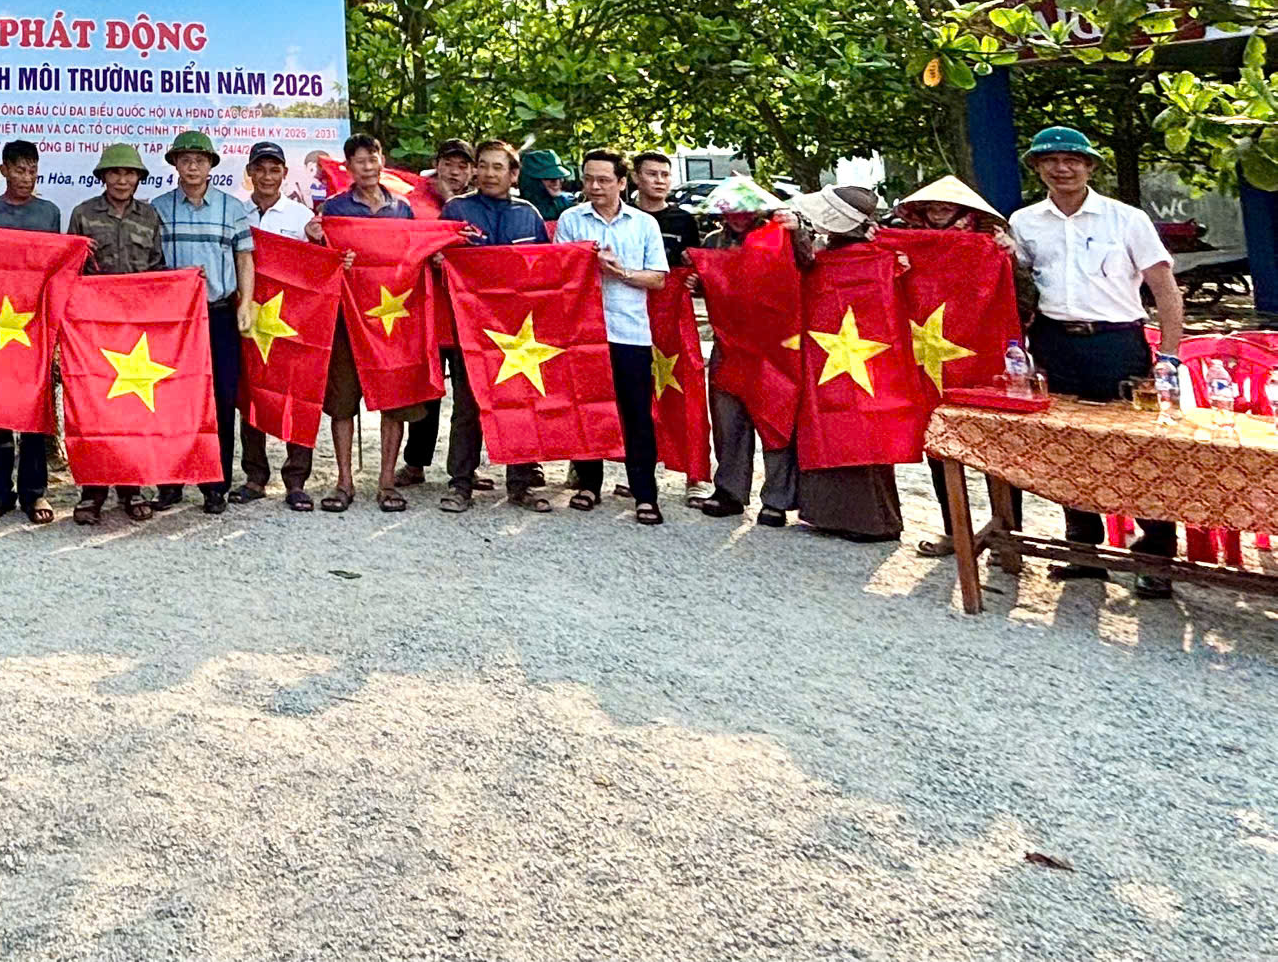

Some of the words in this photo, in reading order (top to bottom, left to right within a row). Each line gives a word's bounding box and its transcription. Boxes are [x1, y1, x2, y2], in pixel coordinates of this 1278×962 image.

[105, 13, 208, 58] ĐỘNG
[18, 62, 60, 91] MÔI
[67, 62, 154, 93] TRƯỜNG
[160, 60, 211, 94] BIỂN
[217, 66, 266, 96] NĂM
[273, 73, 323, 97] 2026
[116, 103, 146, 118] QUỐC
[149, 104, 166, 119] HỘI
[169, 105, 183, 118] VÀ
[185, 108, 215, 119] HĐND
[21, 124, 44, 134] NAM
[213, 124, 232, 138] HỘI
[285, 128, 307, 138] 2026
[315, 129, 337, 139] 2031
[78, 141, 100, 153] THƯ
[48, 172, 75, 186] Hòa,
[166, 173, 174, 185] 4
[1149, 198, 1189, 219] WC
